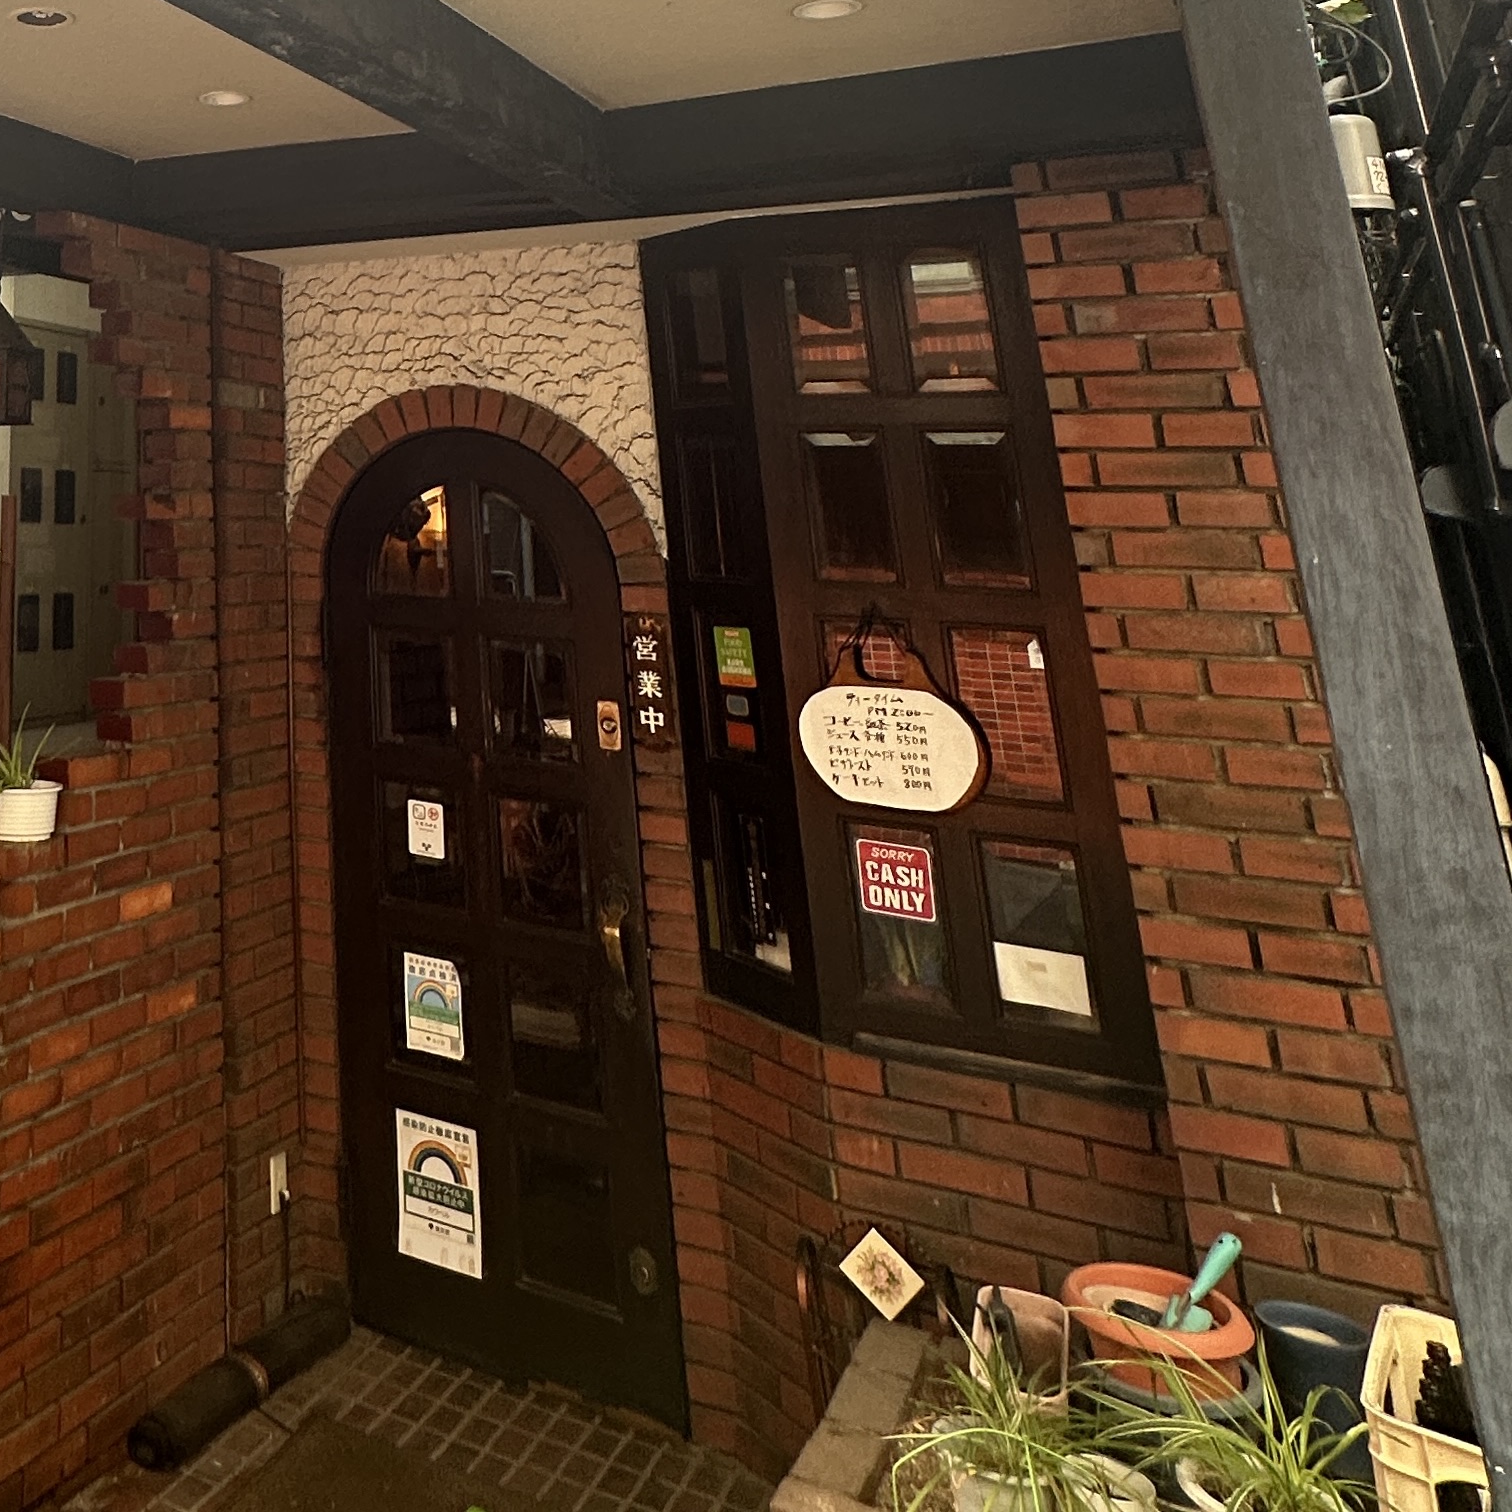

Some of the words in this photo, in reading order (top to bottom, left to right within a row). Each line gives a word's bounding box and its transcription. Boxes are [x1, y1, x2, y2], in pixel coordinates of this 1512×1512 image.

[632, 634, 665, 734] 営業中
[870, 846, 915, 863] SORRY
[865, 860, 924, 889] CASH
[868, 884, 926, 913] ONLY
